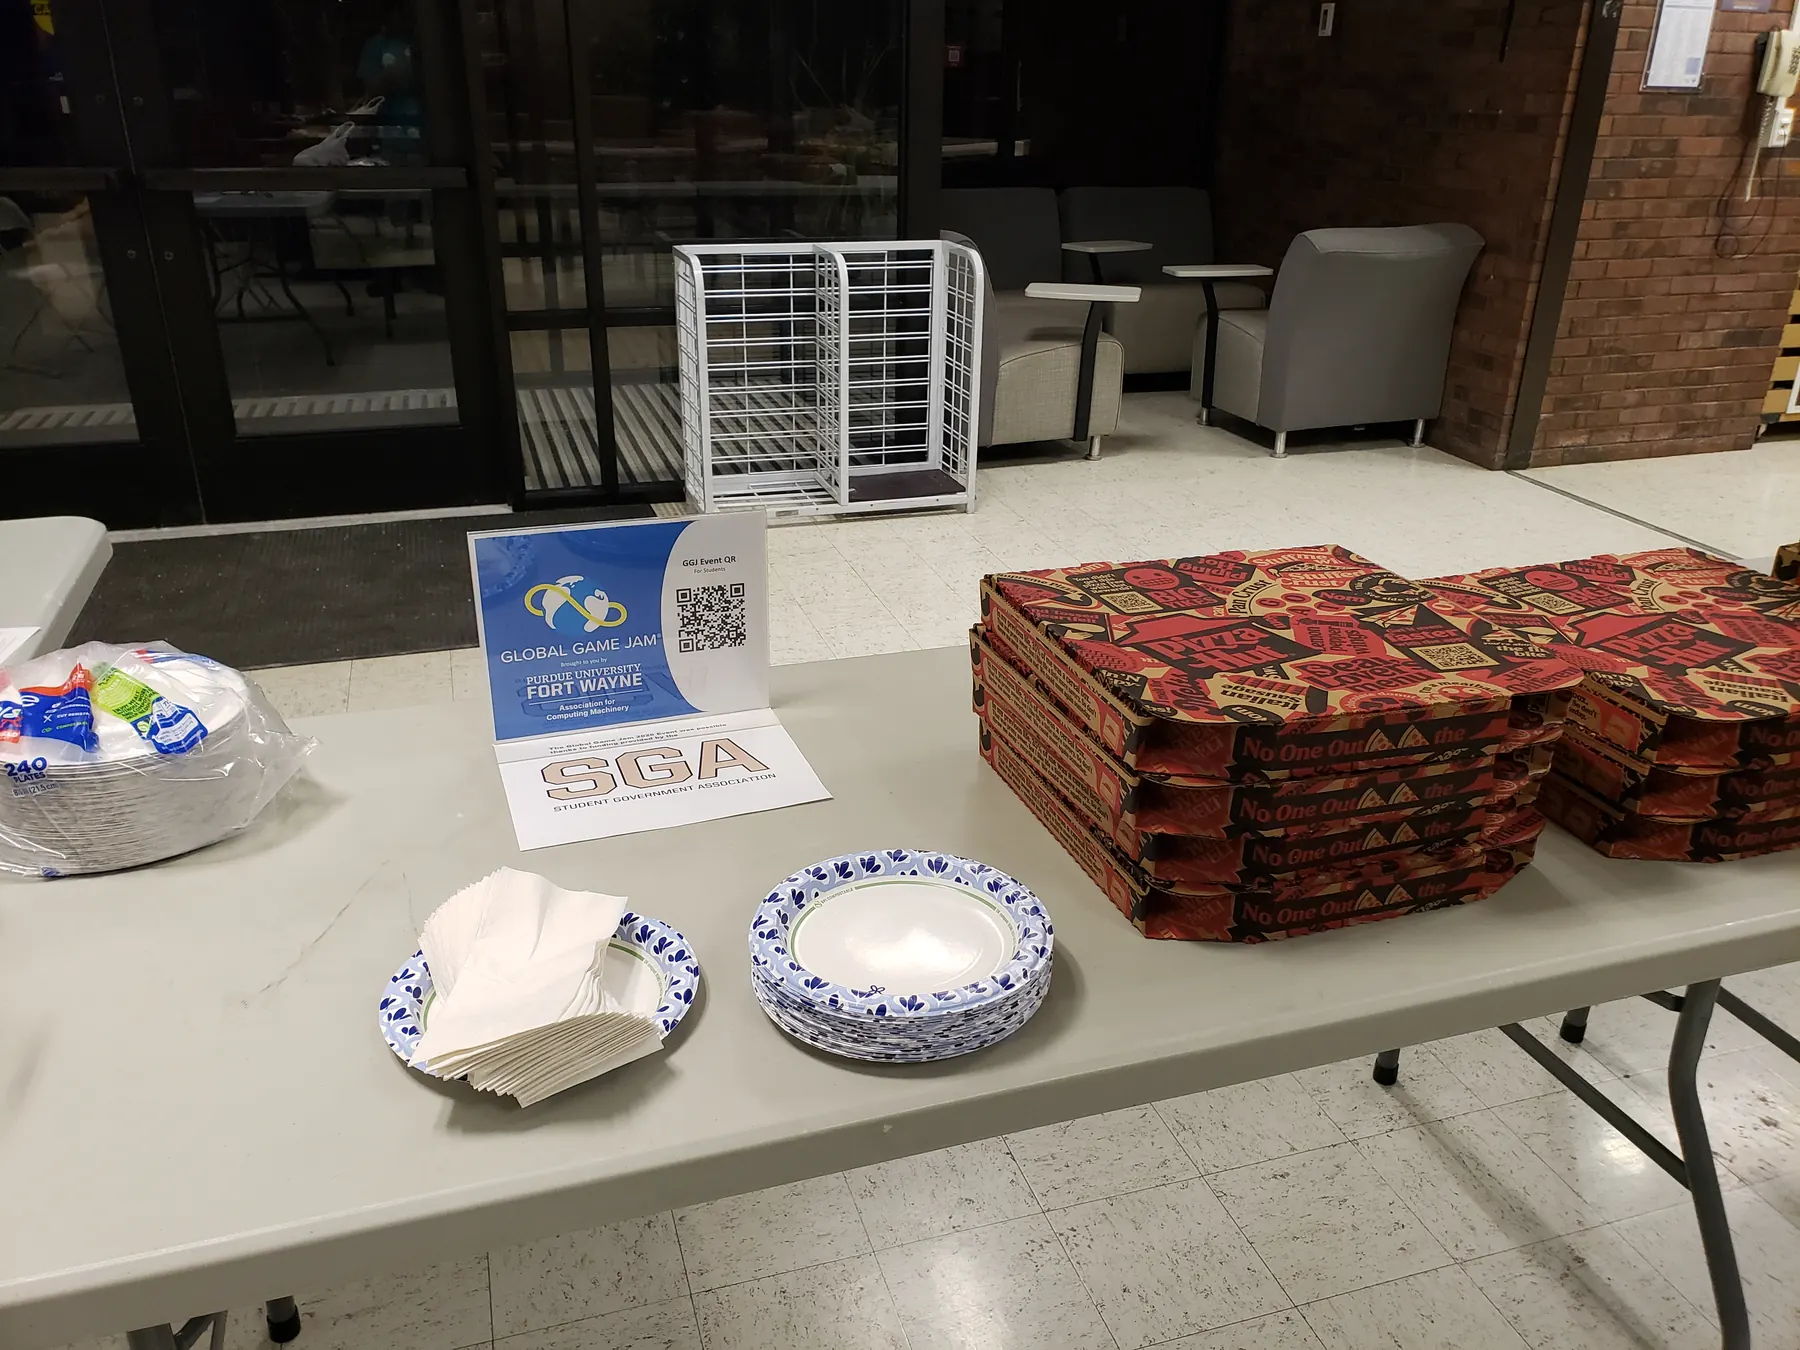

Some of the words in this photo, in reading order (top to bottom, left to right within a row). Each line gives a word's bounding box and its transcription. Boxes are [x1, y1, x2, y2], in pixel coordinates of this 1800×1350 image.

[682, 559, 698, 567] GGJ
[700, 557, 722, 566] Event
[724, 555, 737, 563] QR
[1280, 577, 1340, 588] Crust
[1289, 568, 1366, 580] Stuffed
[1146, 587, 1206, 603] BIG
[1232, 579, 1273, 598] Crust
[1320, 590, 1366, 603] Nom
[1228, 599, 1248, 614] Pan
[1143, 627, 1270, 660] Pizza
[1307, 626, 1327, 652] Lemon
[1345, 629, 1371, 655] wings
[1384, 629, 1457, 643] faster
[1600, 622, 1699, 658] Pizza
[500, 644, 568, 663] GLOBAL
[572, 638, 620, 655] GAME
[1187, 644, 1289, 671] Hut
[1514, 650, 1547, 659] bite
[1649, 639, 1732, 668] Hut
[560, 660, 582, 668] Brought
[601, 657, 608, 665] by
[526, 671, 573, 685] PURDUE
[575, 663, 642, 679] UNIVERSITY
[1346, 672, 1433, 693] menu
[1504, 666, 1581, 692] Different
[1505, 666, 1544, 681] Hits
[526, 682, 575, 700] FORT
[579, 673, 643, 693] WAYNE
[1221, 683, 1303, 703] Sausage
[1708, 687, 1790, 703] Italian
[559, 700, 603, 712] Association
[604, 698, 616, 706] for
[1221, 690, 1300, 711] Italian
[546, 709, 589, 721] Computing
[590, 704, 629, 717] Machinery
[566, 741, 591, 749] Global
[589, 742, 619, 750] funding
[620, 737, 653, 746] provided
[1242, 736, 1275, 762] No
[1279, 743, 1324, 762] One
[1328, 738, 1365, 757] Out
[1434, 726, 1466, 745] the
[1747, 726, 1783, 747] No
[4, 757, 48, 777] 240
[13, 771, 46, 783] PLATES
[541, 738, 770, 800] SGA
[553, 798, 609, 813] STUDENT
[613, 785, 695, 803] GOVERNMENT
[698, 773, 777, 790] ASSOCIATION
[1239, 797, 1271, 823] No
[1275, 803, 1317, 821] One
[1322, 797, 1359, 815] Out
[1424, 783, 1454, 799] the
[1252, 843, 1283, 866] No
[1287, 847, 1326, 865] One
[1329, 840, 1363, 856] Out
[1424, 820, 1453, 837] the
[1240, 901, 1273, 923] No
[1277, 902, 1317, 923] One
[1321, 898, 1357, 917] Out
[1417, 879, 1447, 900] the
